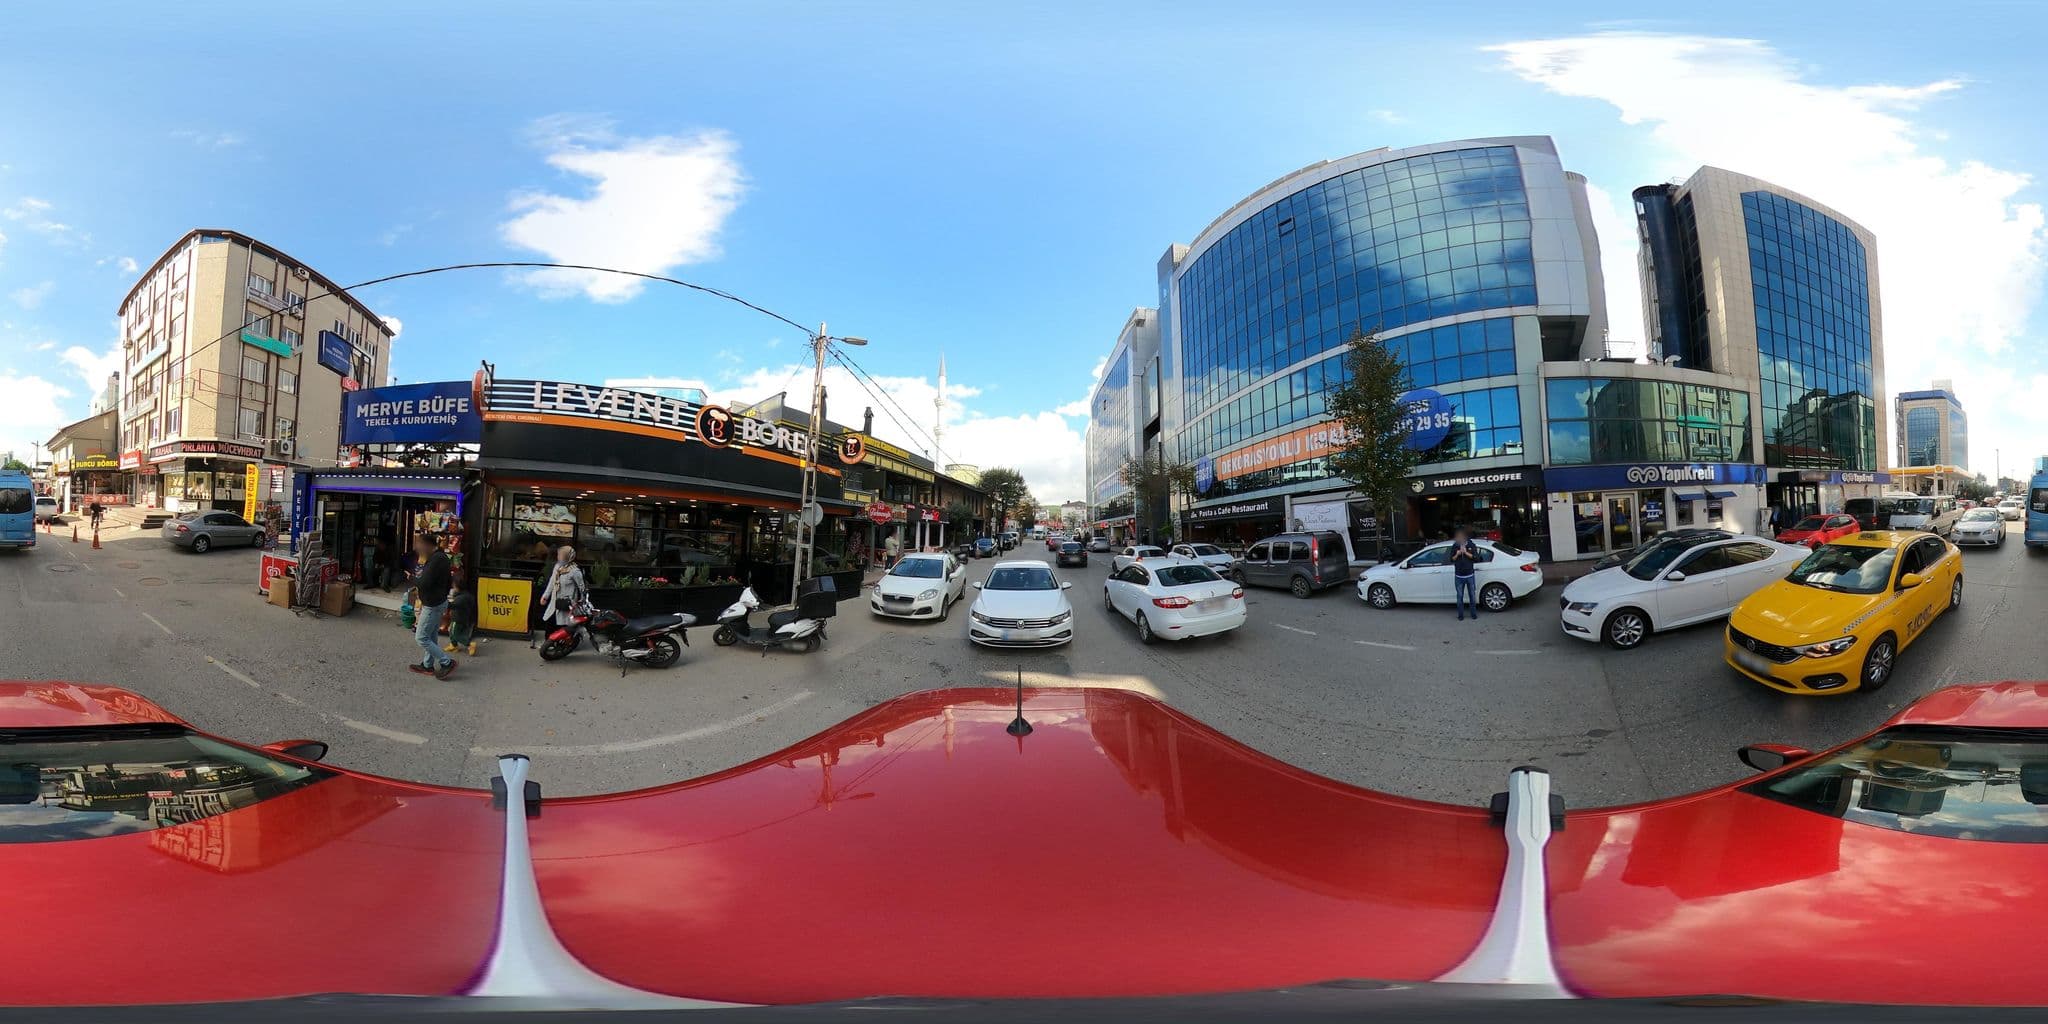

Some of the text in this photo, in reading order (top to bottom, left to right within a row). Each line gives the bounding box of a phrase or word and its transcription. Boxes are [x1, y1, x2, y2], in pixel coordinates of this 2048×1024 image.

[356, 395, 469, 418] MERVE BÜFE
[533, 381, 688, 426] LEVENT
[365, 417, 391, 427] TEKEL
[401, 413, 457, 426] KURUYEMİŞ
[1417, 416, 1431, 431] 29
[1434, 412, 1449, 428] 35
[181, 442, 216, 453] PIRLANTA
[218, 443, 262, 458] MÜCEVHERAT
[1221, 437, 1300, 474] DEKORASYONLU
[1433, 473, 1522, 487] STARBUCKS COFFEE
[1659, 466, 1715, 483] YapıKredi
[1232, 502, 1268, 513] Restaurant
[487, 594, 520, 605] MERVE
